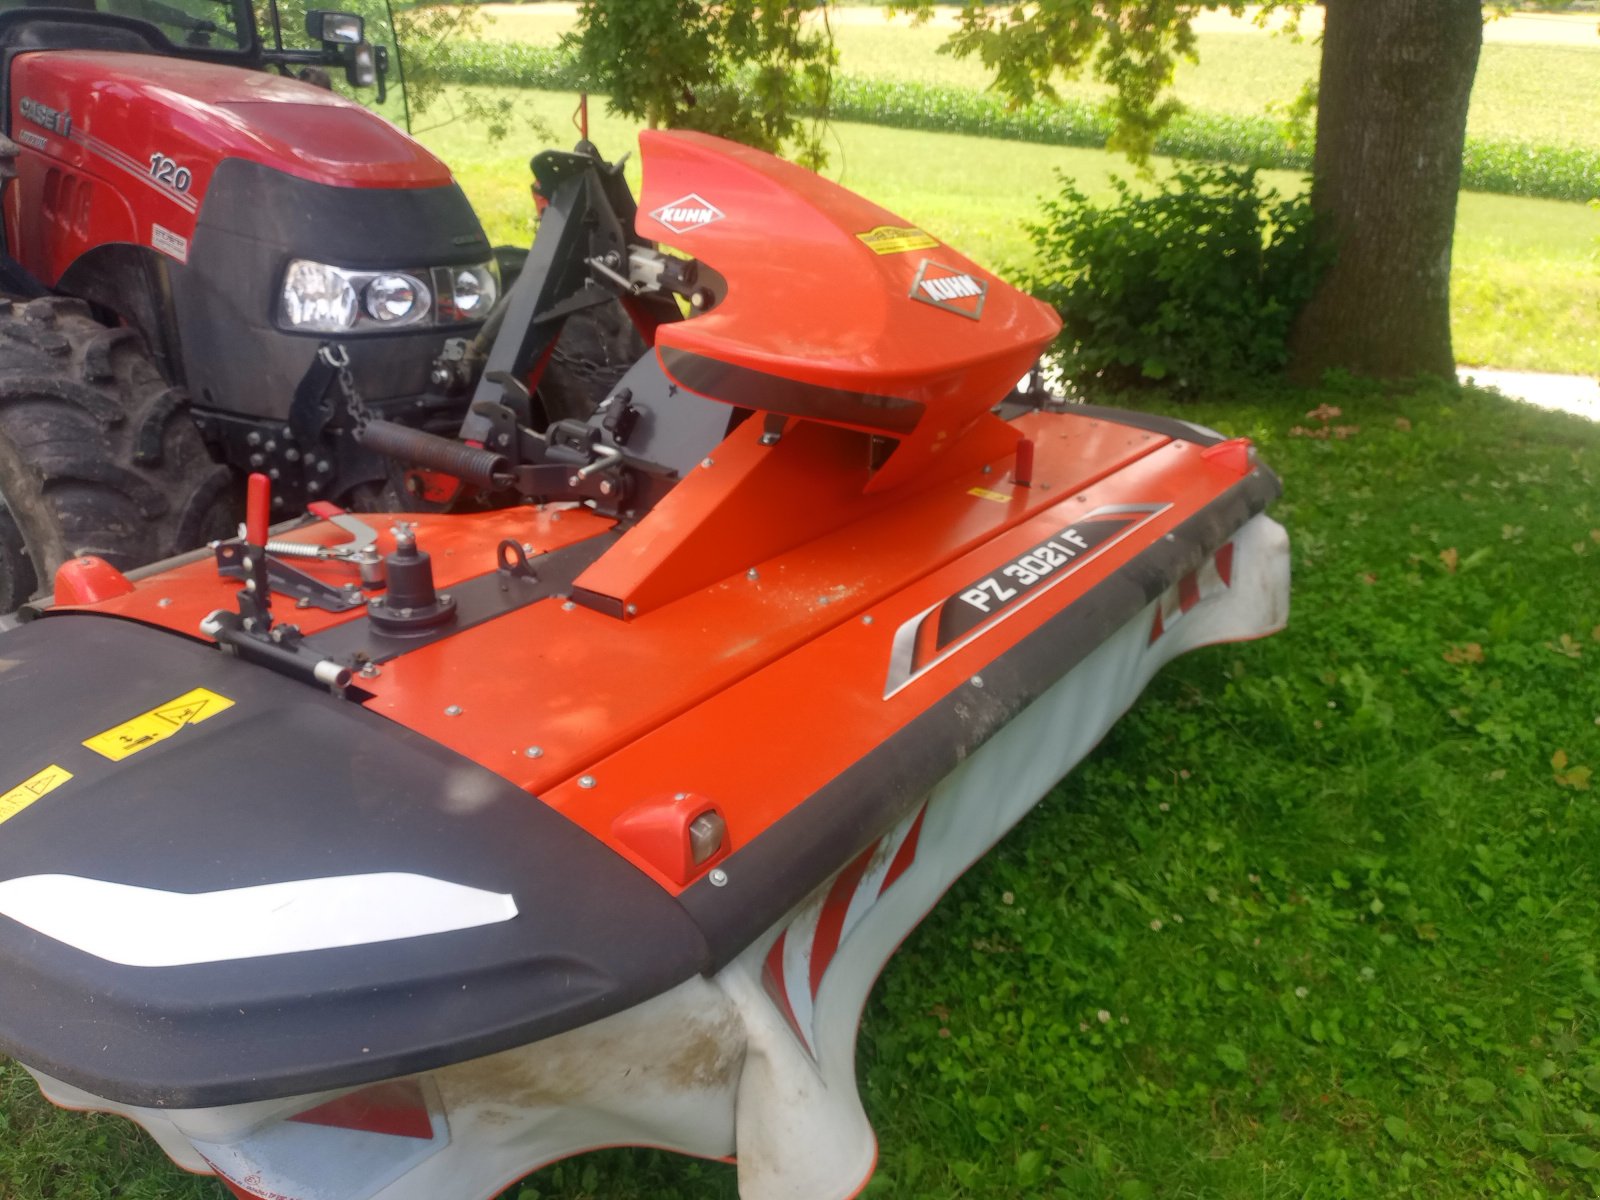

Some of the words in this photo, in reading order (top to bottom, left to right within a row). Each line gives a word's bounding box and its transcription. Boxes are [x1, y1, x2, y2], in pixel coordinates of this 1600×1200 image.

[150, 152, 192, 195] 120
[660, 207, 713, 223] KUHN
[920, 274, 983, 302] KUHN
[959, 578, 1017, 613] PZ
[1003, 541, 1076, 586] 3021
[1060, 528, 1088, 549] F
